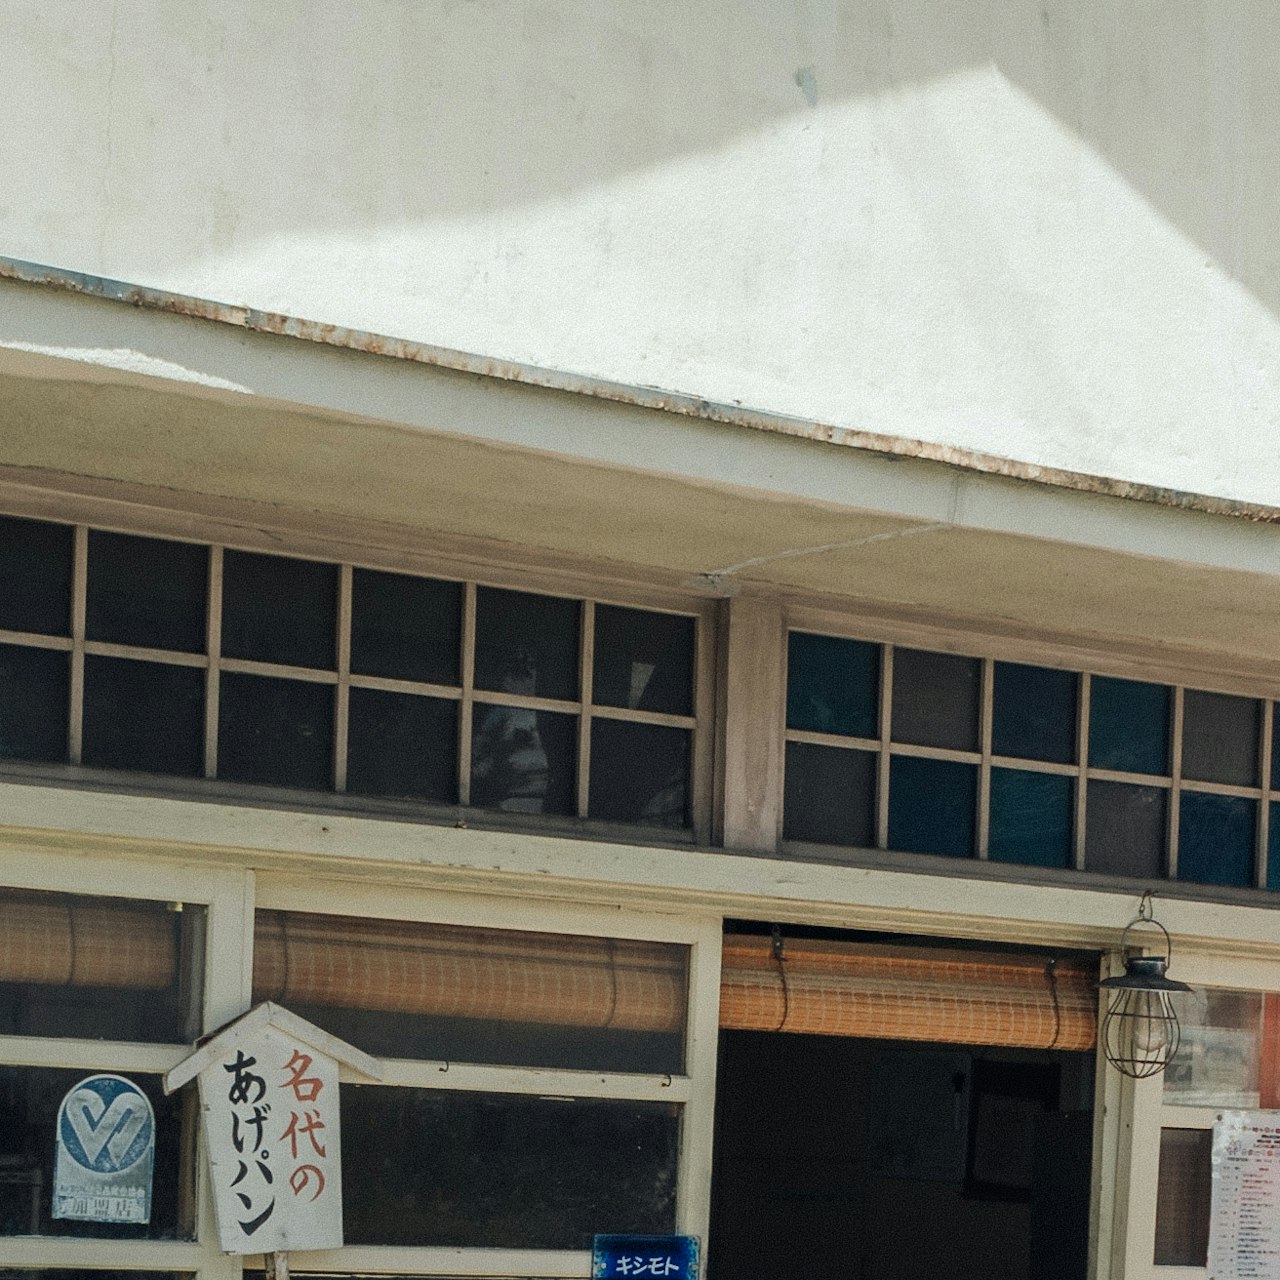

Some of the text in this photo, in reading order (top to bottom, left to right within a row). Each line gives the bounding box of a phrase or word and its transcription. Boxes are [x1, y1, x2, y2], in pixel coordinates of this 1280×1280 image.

[222, 1049, 276, 1237] あげパン
[278, 1048, 326, 1203] 名代の
[615, 1255, 680, 1277] キシモト
